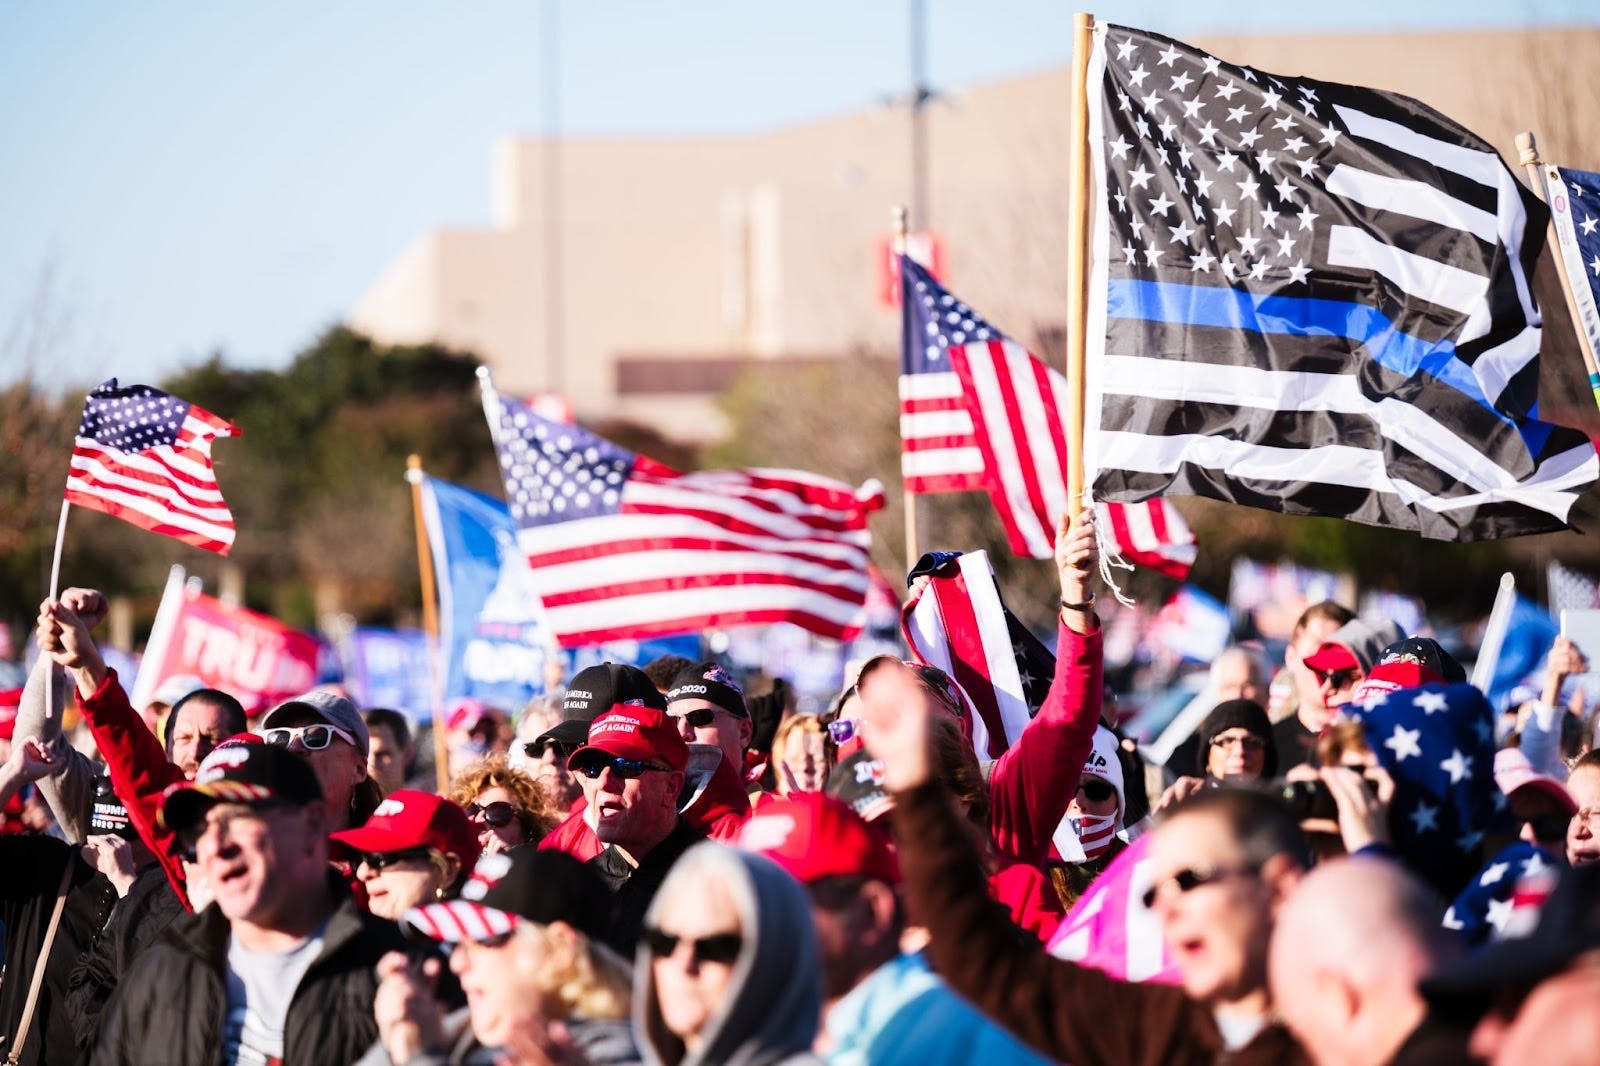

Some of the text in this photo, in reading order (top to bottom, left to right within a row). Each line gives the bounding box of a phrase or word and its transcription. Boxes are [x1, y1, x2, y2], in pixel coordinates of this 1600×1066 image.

[680, 684, 707, 694] 2020
[605, 714, 640, 725] AMERICA
[607, 723, 635, 733] AGAIN
[94, 803, 128, 816] TRUMP
[92, 819, 114, 829] 2020
